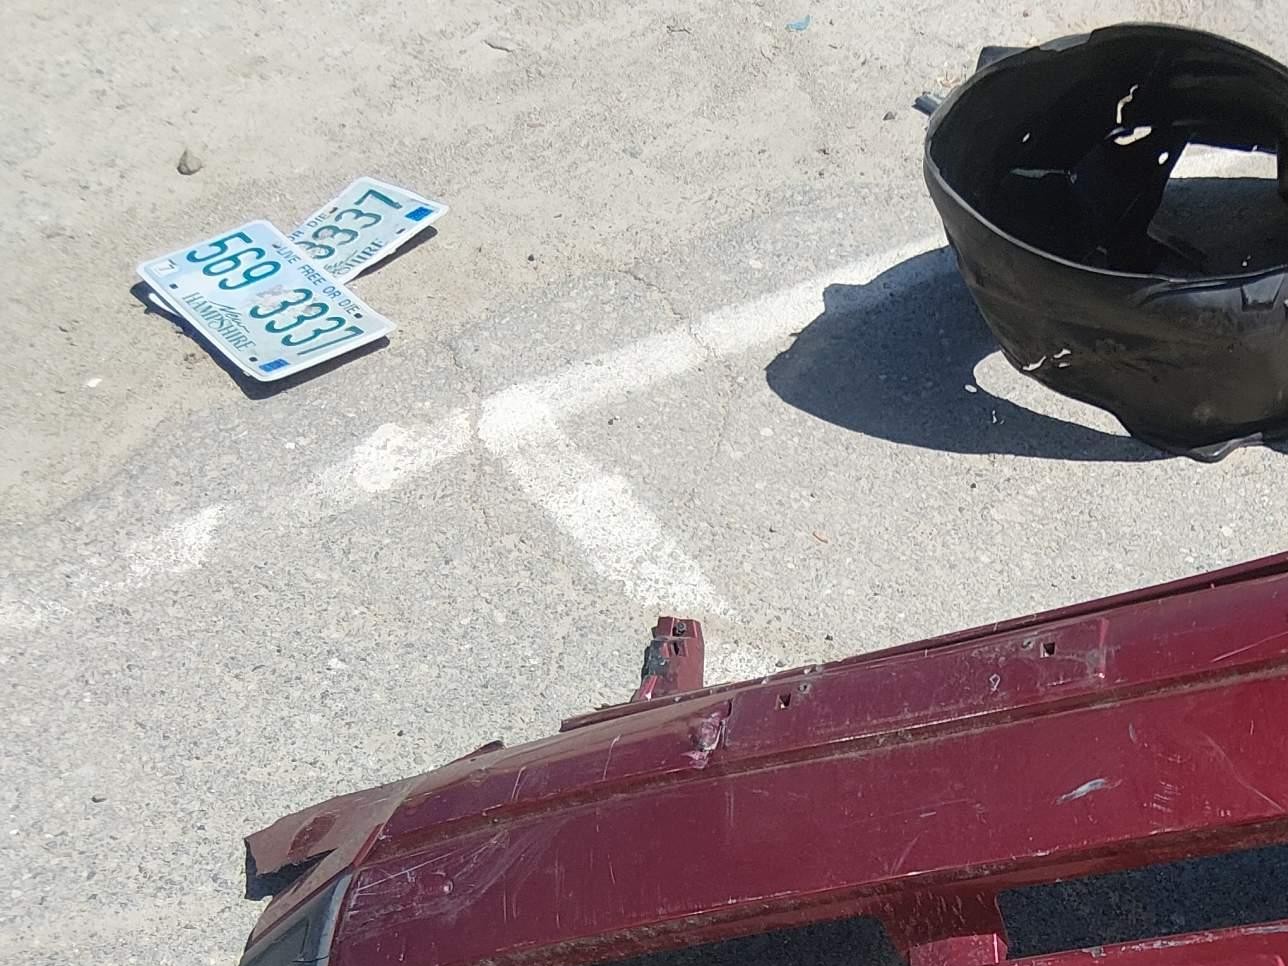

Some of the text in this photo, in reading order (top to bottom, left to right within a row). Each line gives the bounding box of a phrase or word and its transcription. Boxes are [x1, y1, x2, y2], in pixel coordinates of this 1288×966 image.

[306, 212, 327, 229] DIE
[186, 232, 364, 356] 569 3337
[276, 244, 302, 265] LIVE
[298, 264, 327, 287] FREE
[323, 286, 342, 300] OR
[338, 299, 361, 315] DIE
[183, 292, 256, 351] HAMPSHIRE
